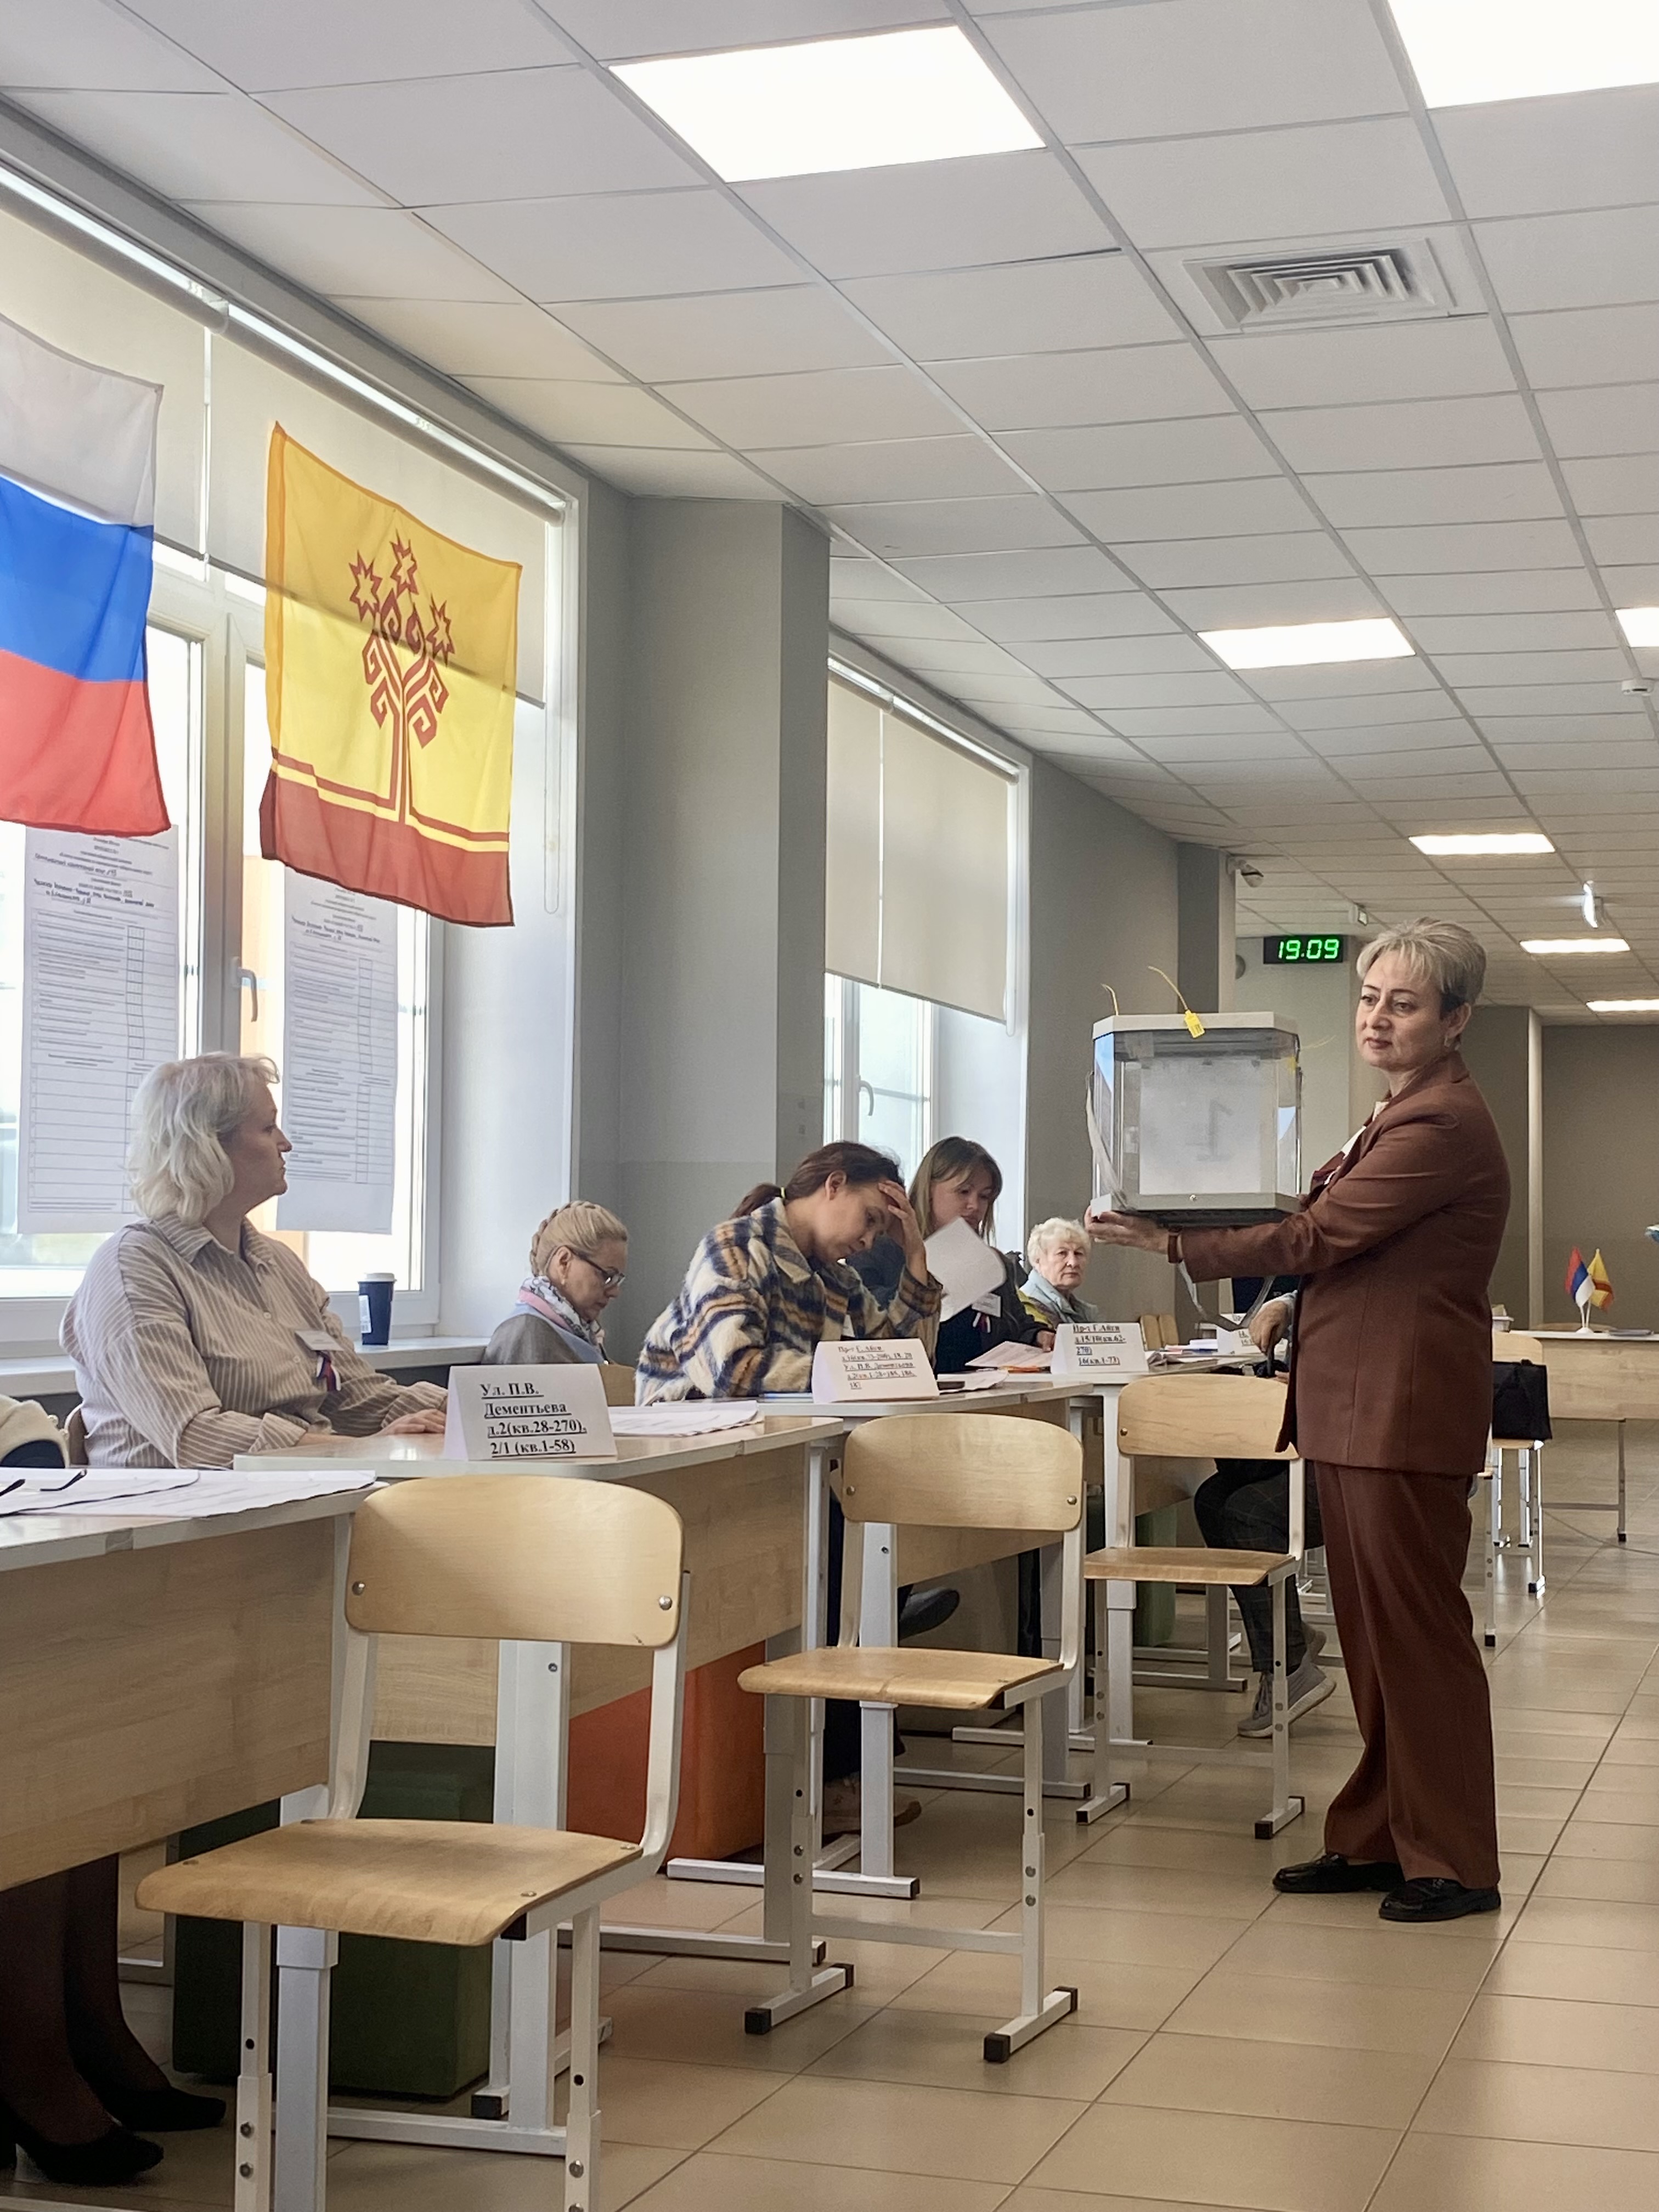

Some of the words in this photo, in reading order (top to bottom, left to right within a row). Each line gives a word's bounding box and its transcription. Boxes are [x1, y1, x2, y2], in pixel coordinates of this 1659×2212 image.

[480, 1383, 505, 1396] Ул.
[509, 1382, 540, 1395] П.В.
[484, 1402, 567, 1417] Дементьева
[490, 1441, 510, 1455] 2/1
[514, 1439, 575, 1455] (кв.1-58)
